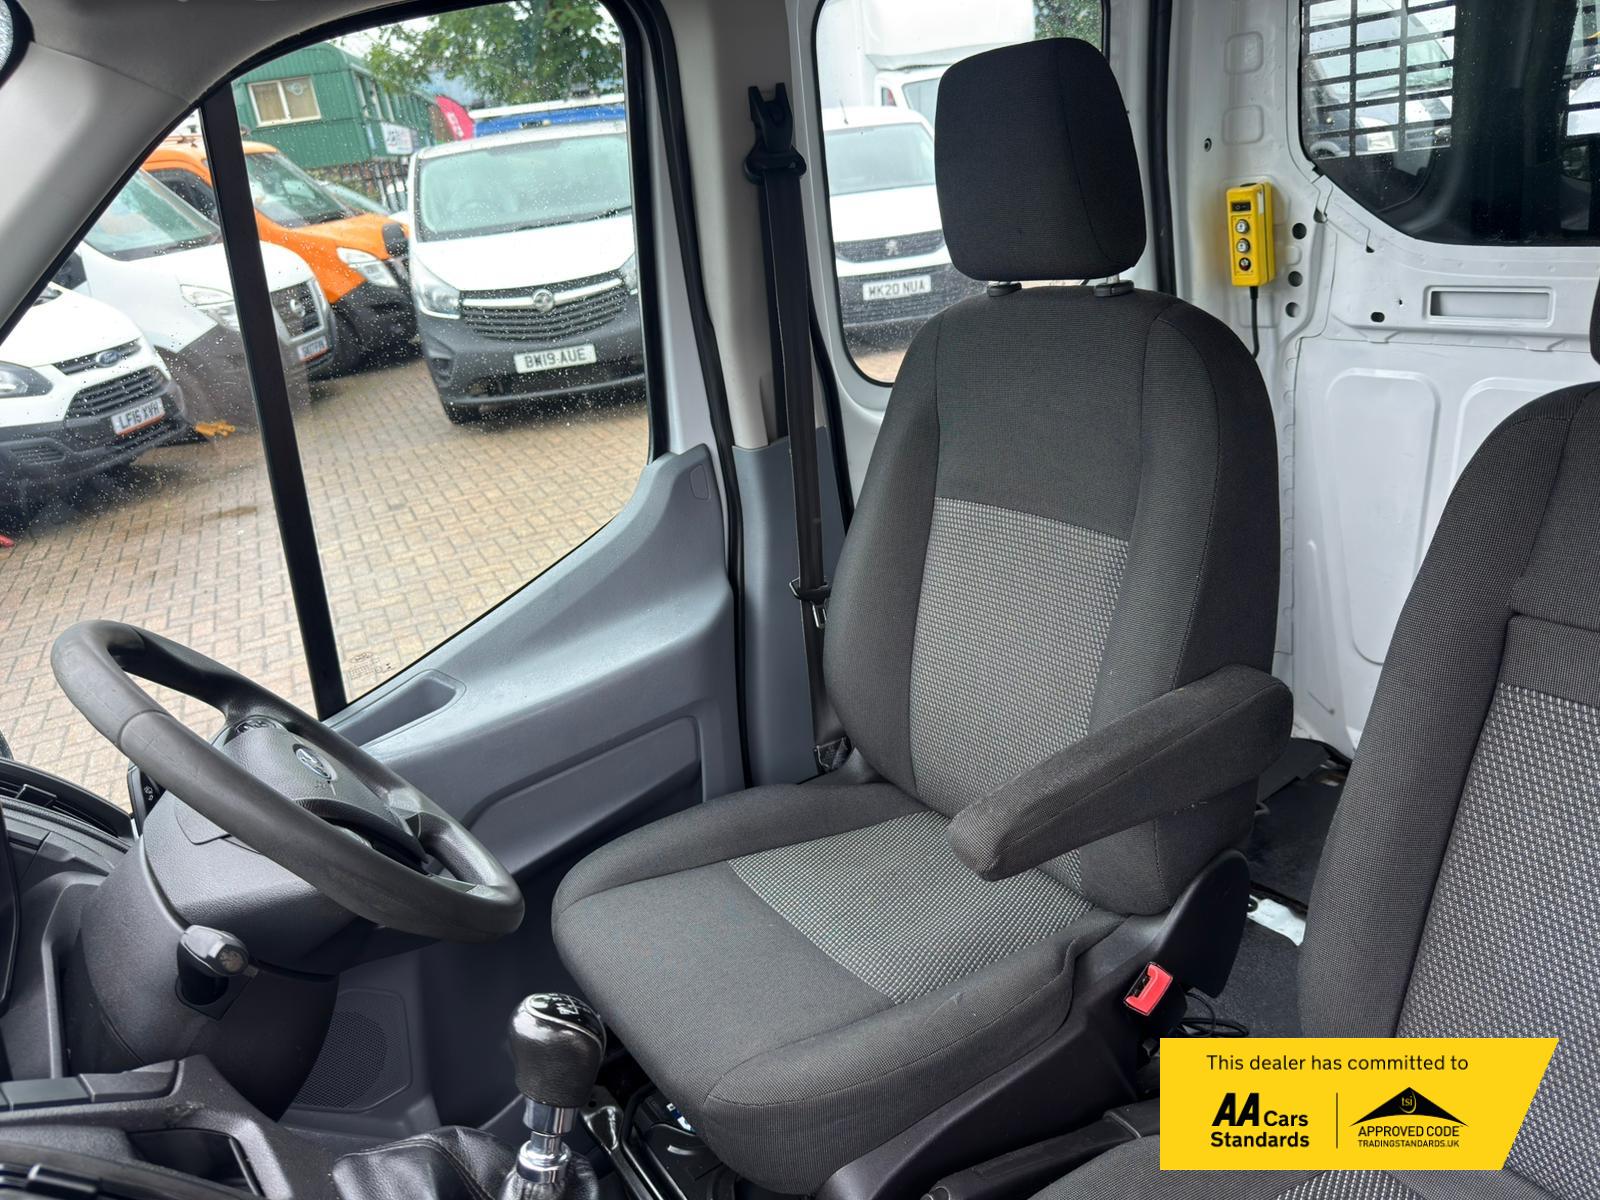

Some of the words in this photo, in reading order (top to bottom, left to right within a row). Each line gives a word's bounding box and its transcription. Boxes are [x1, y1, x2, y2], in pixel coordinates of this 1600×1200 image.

[868, 283, 900, 298] WK20
[902, 279, 926, 293] NUA
[524, 352, 556, 368] BW19
[560, 347, 588, 365] AUE
